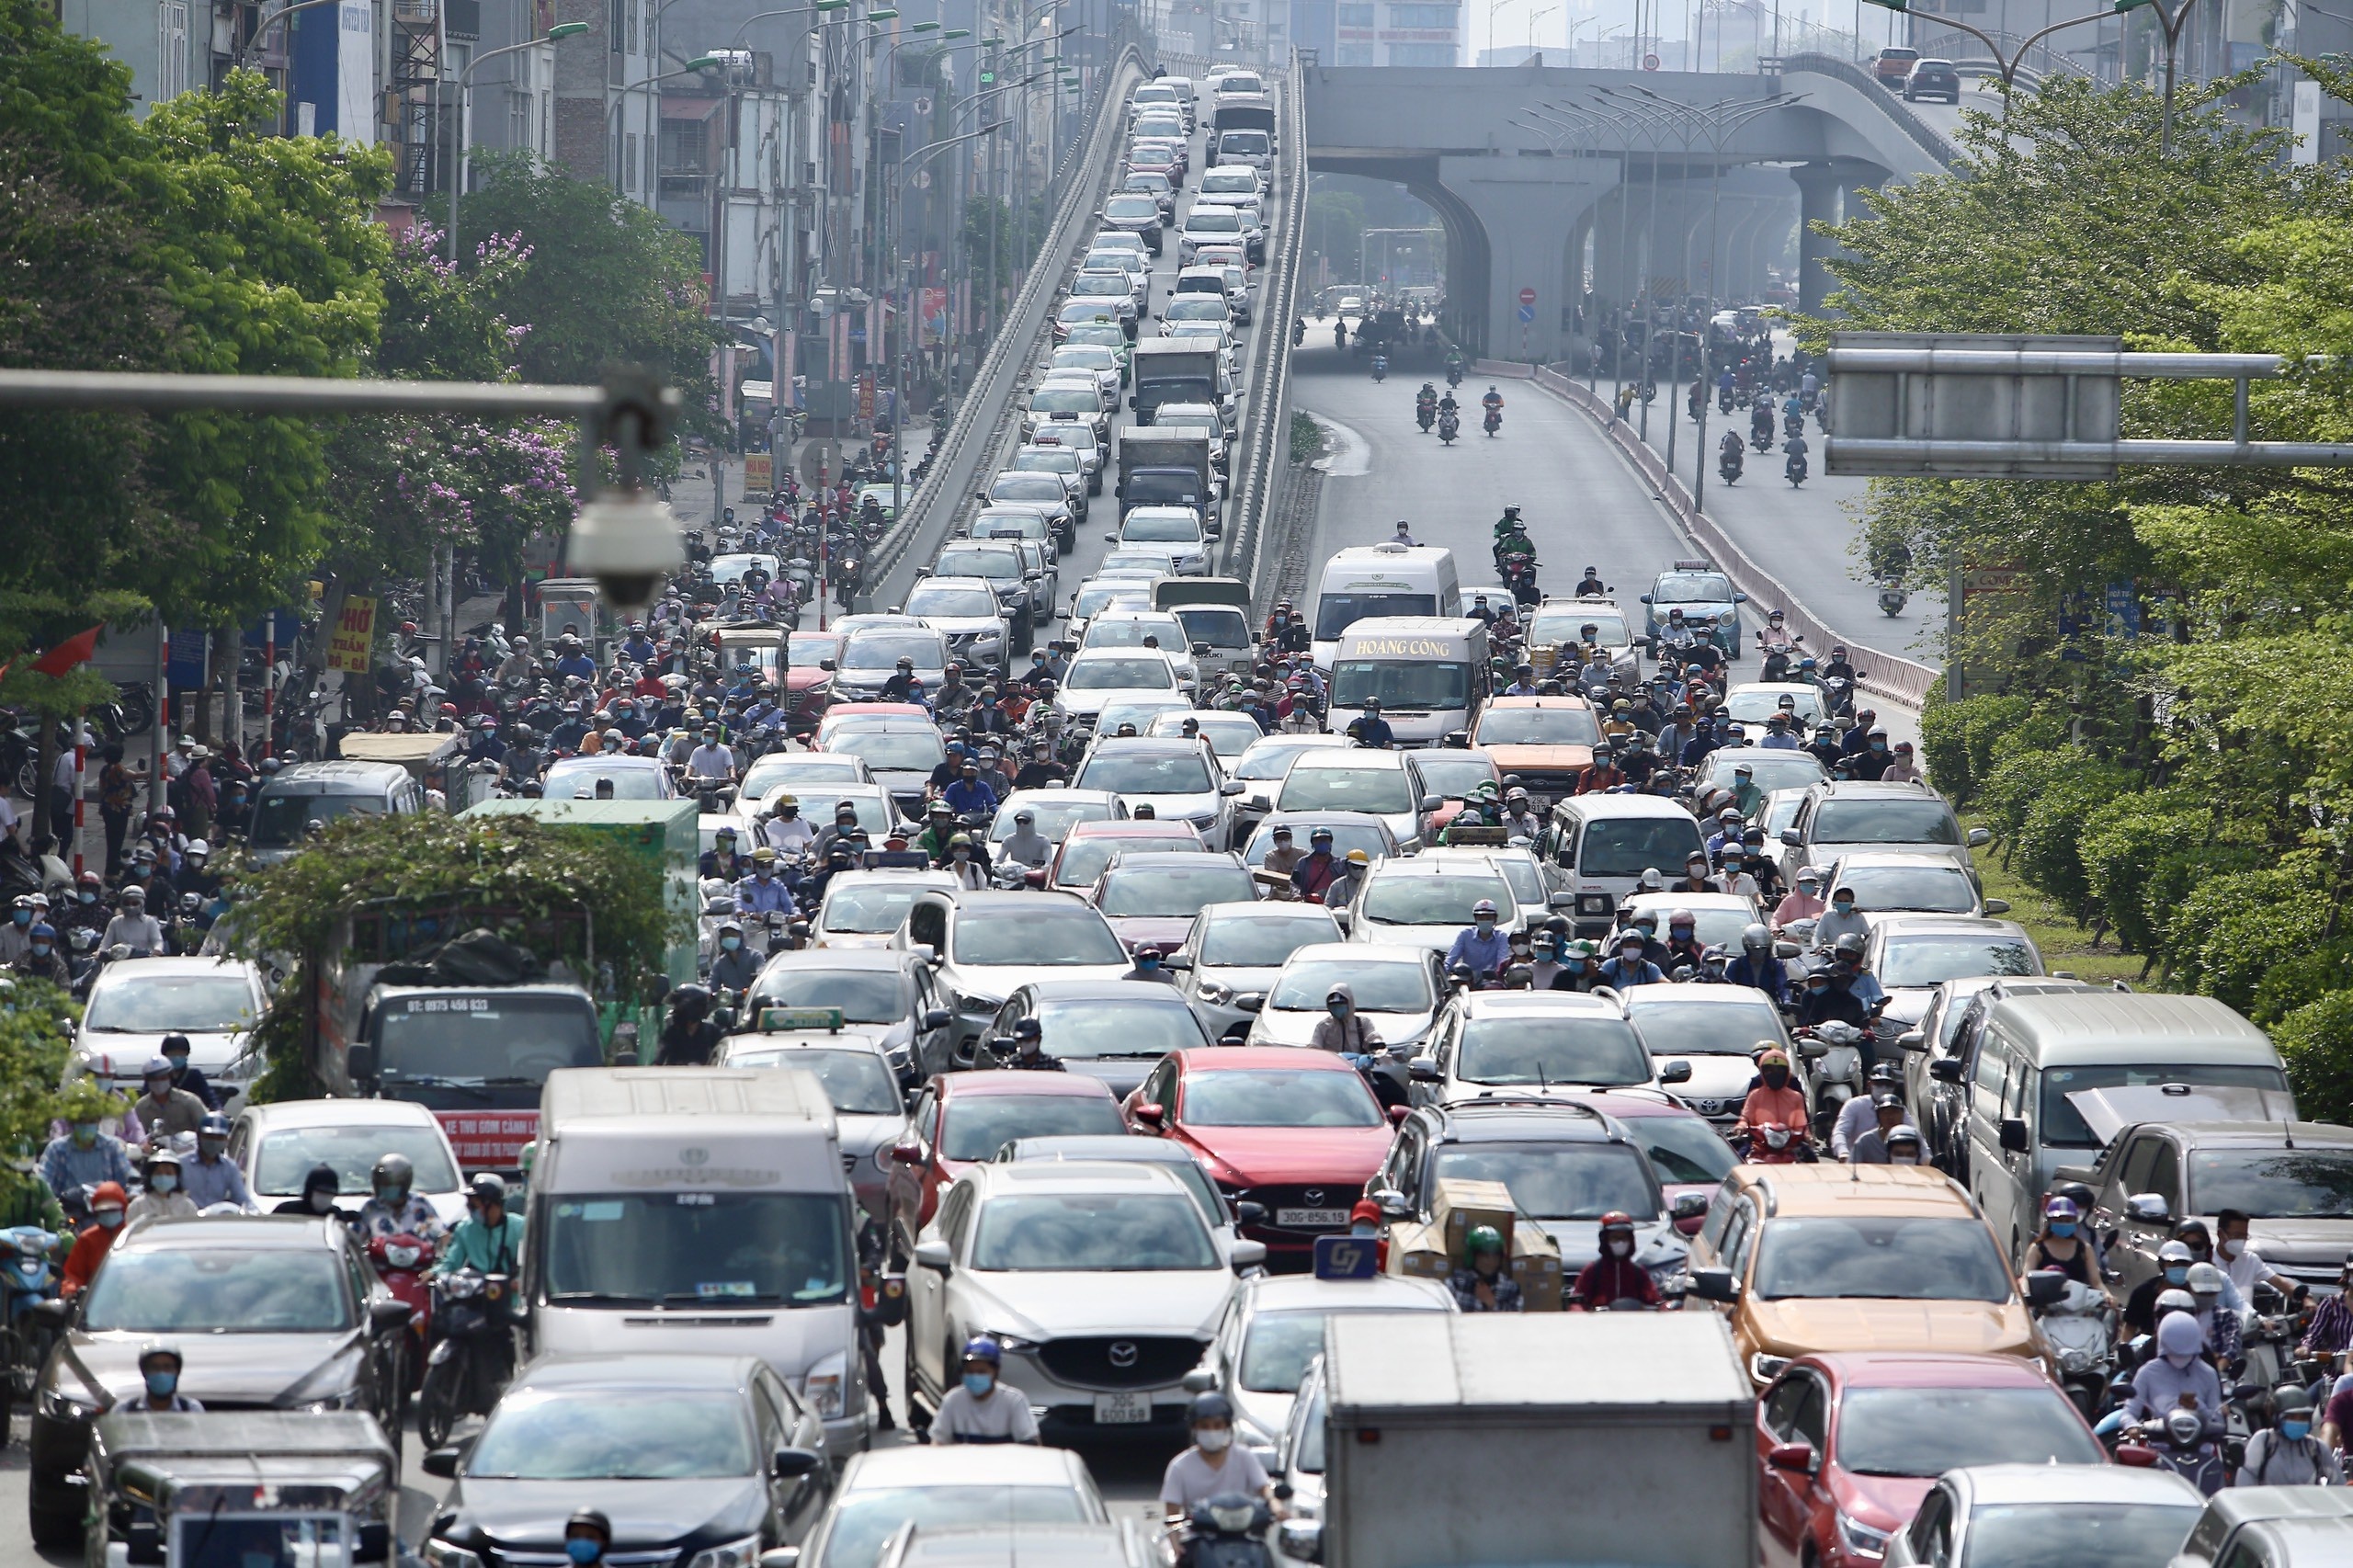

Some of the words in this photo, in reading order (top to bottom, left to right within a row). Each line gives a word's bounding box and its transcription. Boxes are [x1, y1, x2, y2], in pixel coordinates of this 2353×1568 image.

[1355, 636, 1407, 655] HOÀNG
[1409, 638, 1449, 657] CÔNG
[1330, 1241, 1362, 1274] G7
